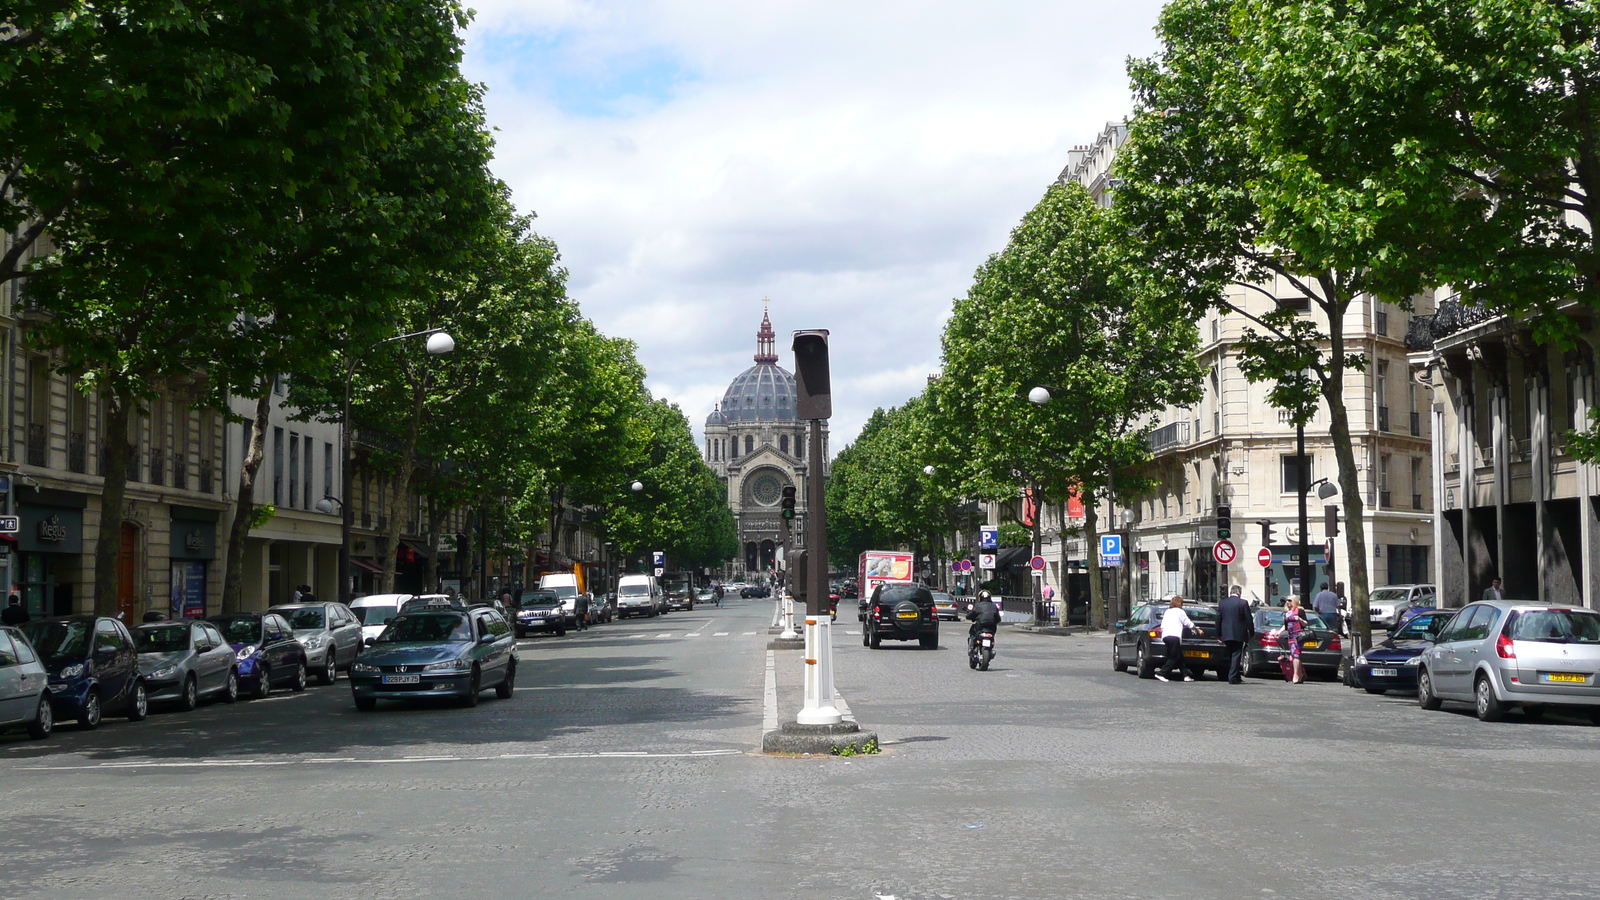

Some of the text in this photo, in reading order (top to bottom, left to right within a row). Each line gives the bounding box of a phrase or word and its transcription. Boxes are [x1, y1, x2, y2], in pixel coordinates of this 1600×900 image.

[42, 520, 66, 542] Regus
[982, 531, 992, 544] P
[1288, 526, 1311, 537] LC
[1106, 539, 1116, 552] P
